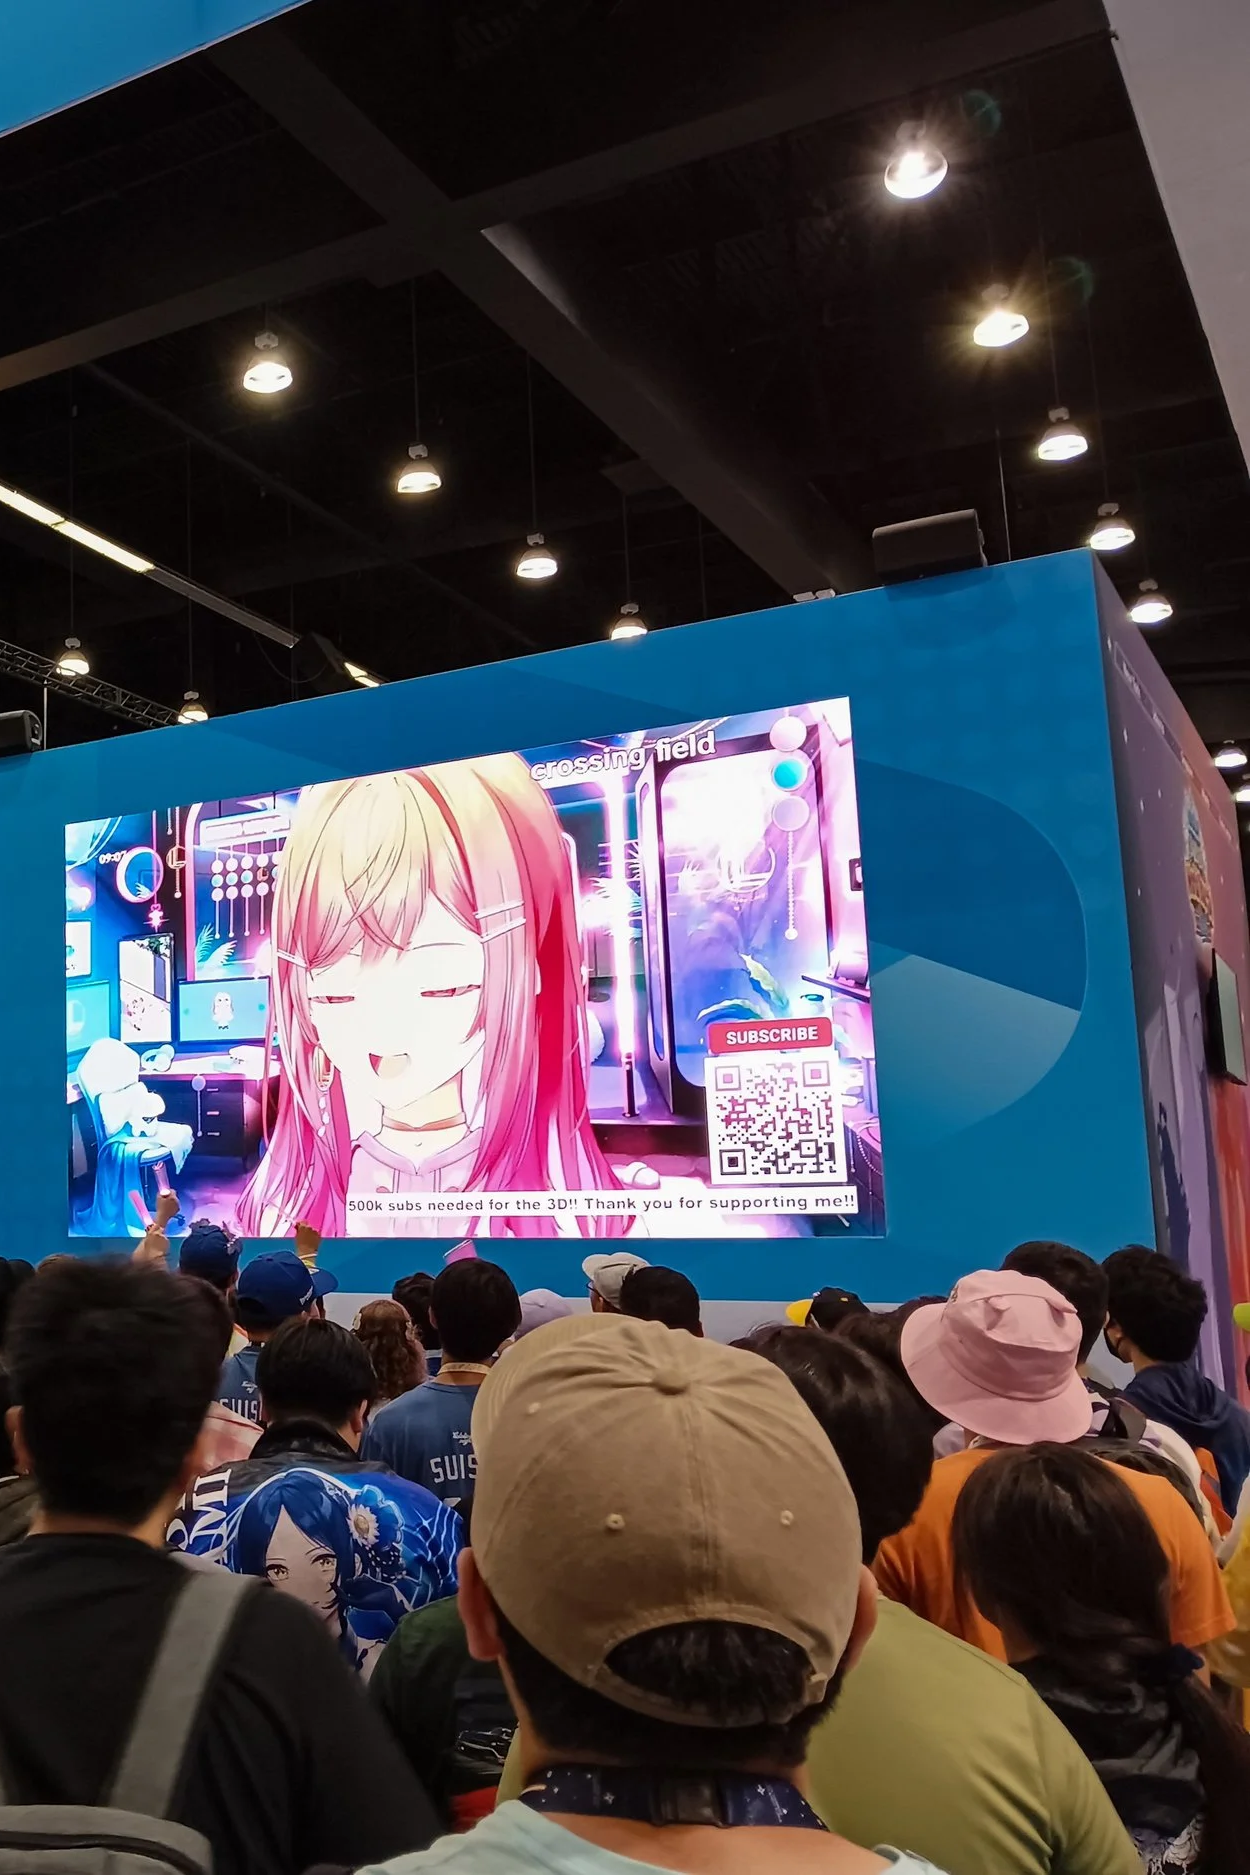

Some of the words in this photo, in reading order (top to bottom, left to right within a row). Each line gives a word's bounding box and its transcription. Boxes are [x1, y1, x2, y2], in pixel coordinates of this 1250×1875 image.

[530, 747, 646, 781] crossing
[654, 730, 716, 763] field
[726, 1026, 819, 1045] SUBSCRIBE
[348, 1199, 383, 1212] 500k
[388, 1199, 422, 1212] subs
[427, 1198, 483, 1211] needed
[488, 1198, 510, 1210] for
[516, 1198, 541, 1210] the
[547, 1197, 578, 1210] 3D!!
[584, 1197, 637, 1210] Thank
[643, 1199, 673, 1212] you
[679, 1197, 703, 1209] for
[709, 1195, 808, 1211] supporting
[815, 1194, 856, 1208] me!!
